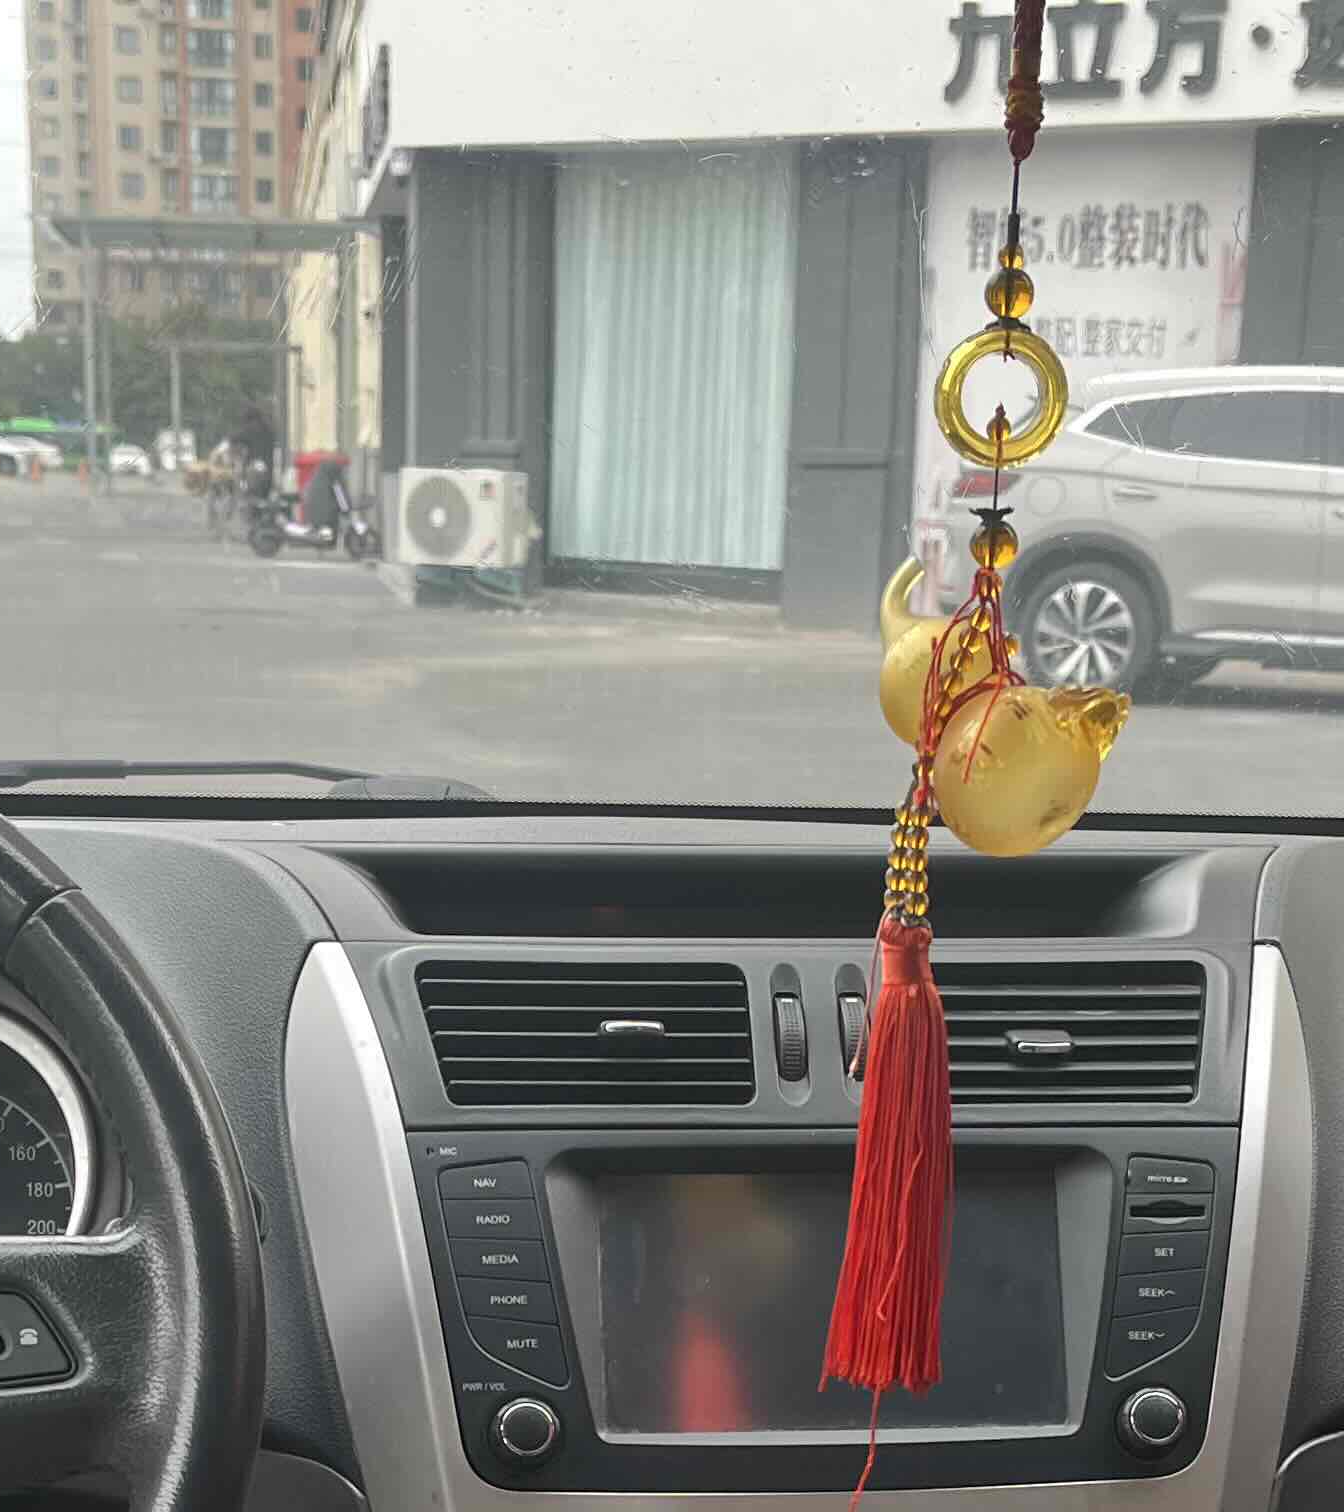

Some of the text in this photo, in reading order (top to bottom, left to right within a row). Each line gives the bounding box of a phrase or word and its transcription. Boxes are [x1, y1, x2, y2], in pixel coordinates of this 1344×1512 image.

[9, 1146, 36, 1161] 160
[473, 1178, 497, 1188] NAV
[27, 1183, 54, 1198] 180
[476, 1214, 510, 1225] RADIO
[27, 1219, 56, 1235] 200
[1154, 1247, 1175, 1257] SET
[481, 1254, 519, 1265] MEDIA
[490, 1294, 528, 1305] PHONE
[507, 1338, 538, 1349] MUTE
